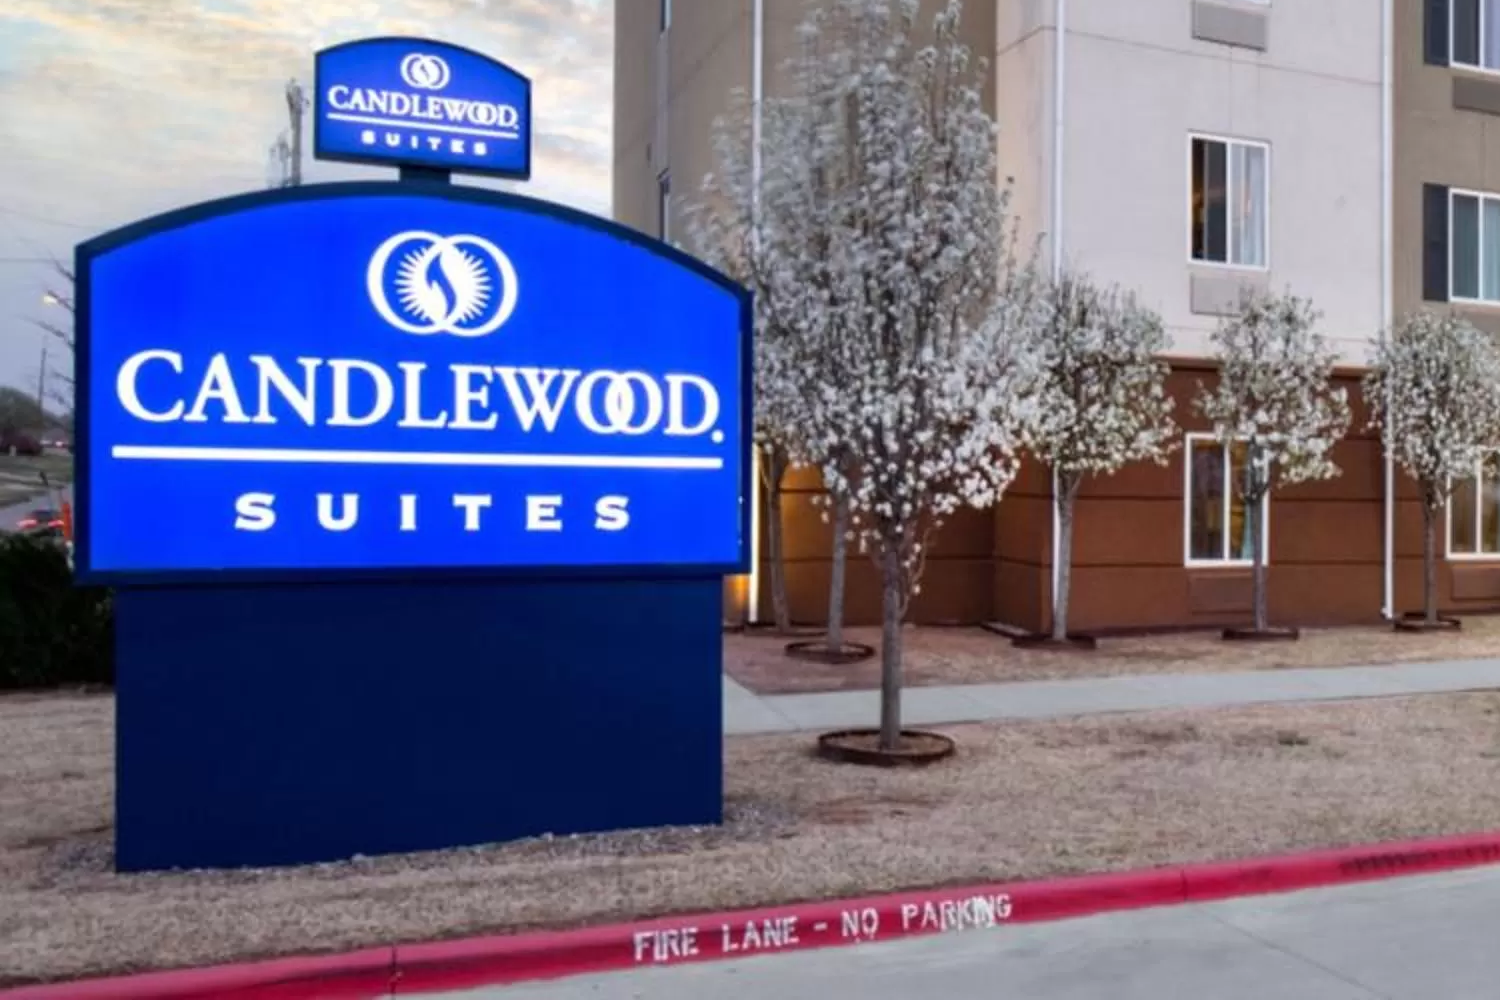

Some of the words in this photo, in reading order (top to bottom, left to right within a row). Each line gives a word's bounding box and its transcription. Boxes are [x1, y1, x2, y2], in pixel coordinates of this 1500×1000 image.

[361, 130, 487, 155] SUITES
[234, 492, 630, 531] SUITES
[634, 928, 699, 961] FIRE
[722, 916, 800, 952] LANE
[842, 907, 880, 937] NO
[902, 894, 1011, 931] PARKING
